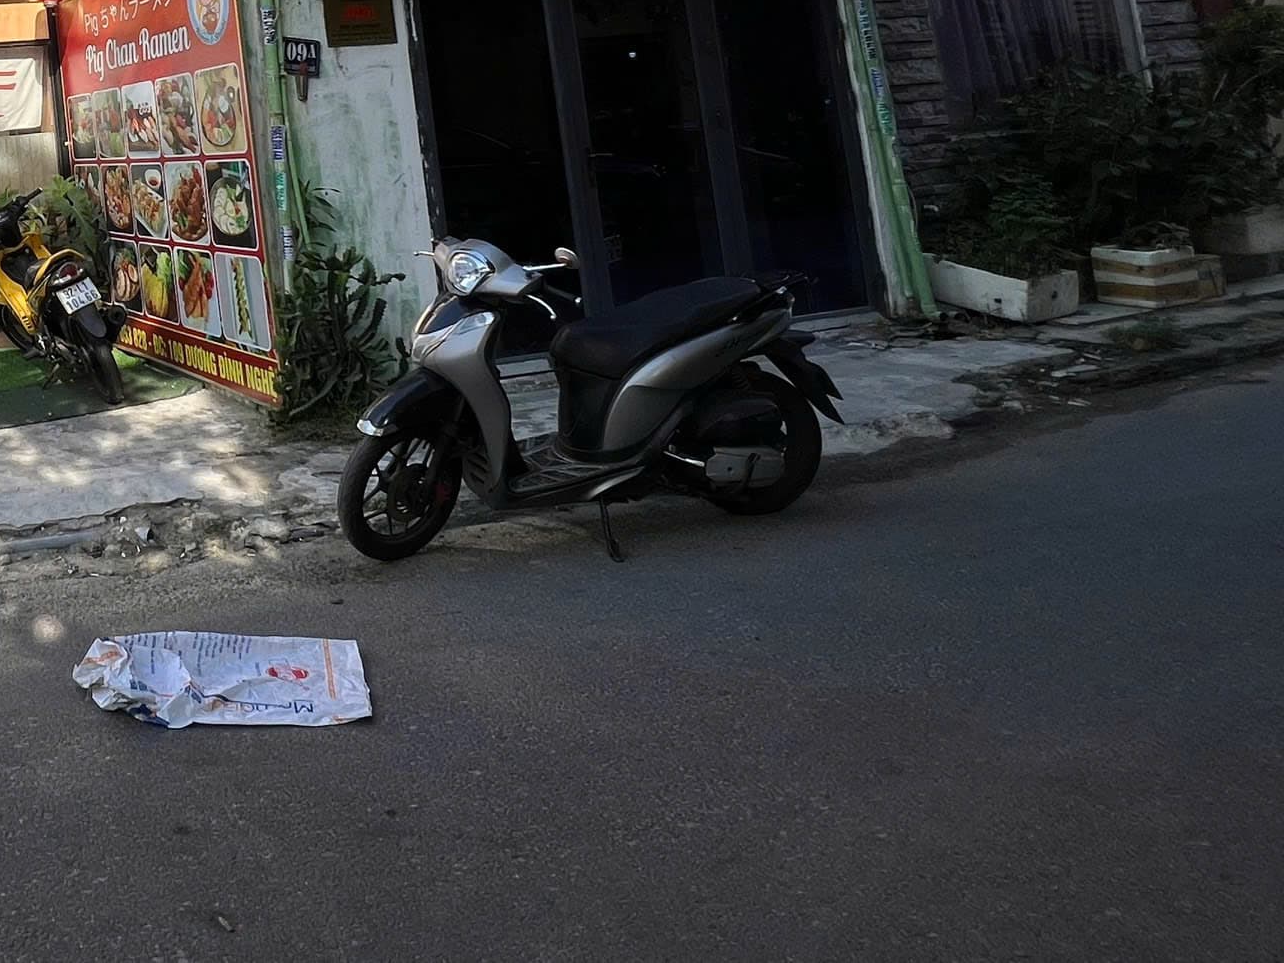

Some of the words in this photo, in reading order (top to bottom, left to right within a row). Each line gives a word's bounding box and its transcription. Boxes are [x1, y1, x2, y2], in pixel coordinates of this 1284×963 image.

[84, 13, 99, 36] Pig
[86, 44, 104, 82] Pig
[106, 38, 139, 70] Chan
[139, 27, 191, 62] Ramen
[217, 351, 245, 386] ĐÌNH
